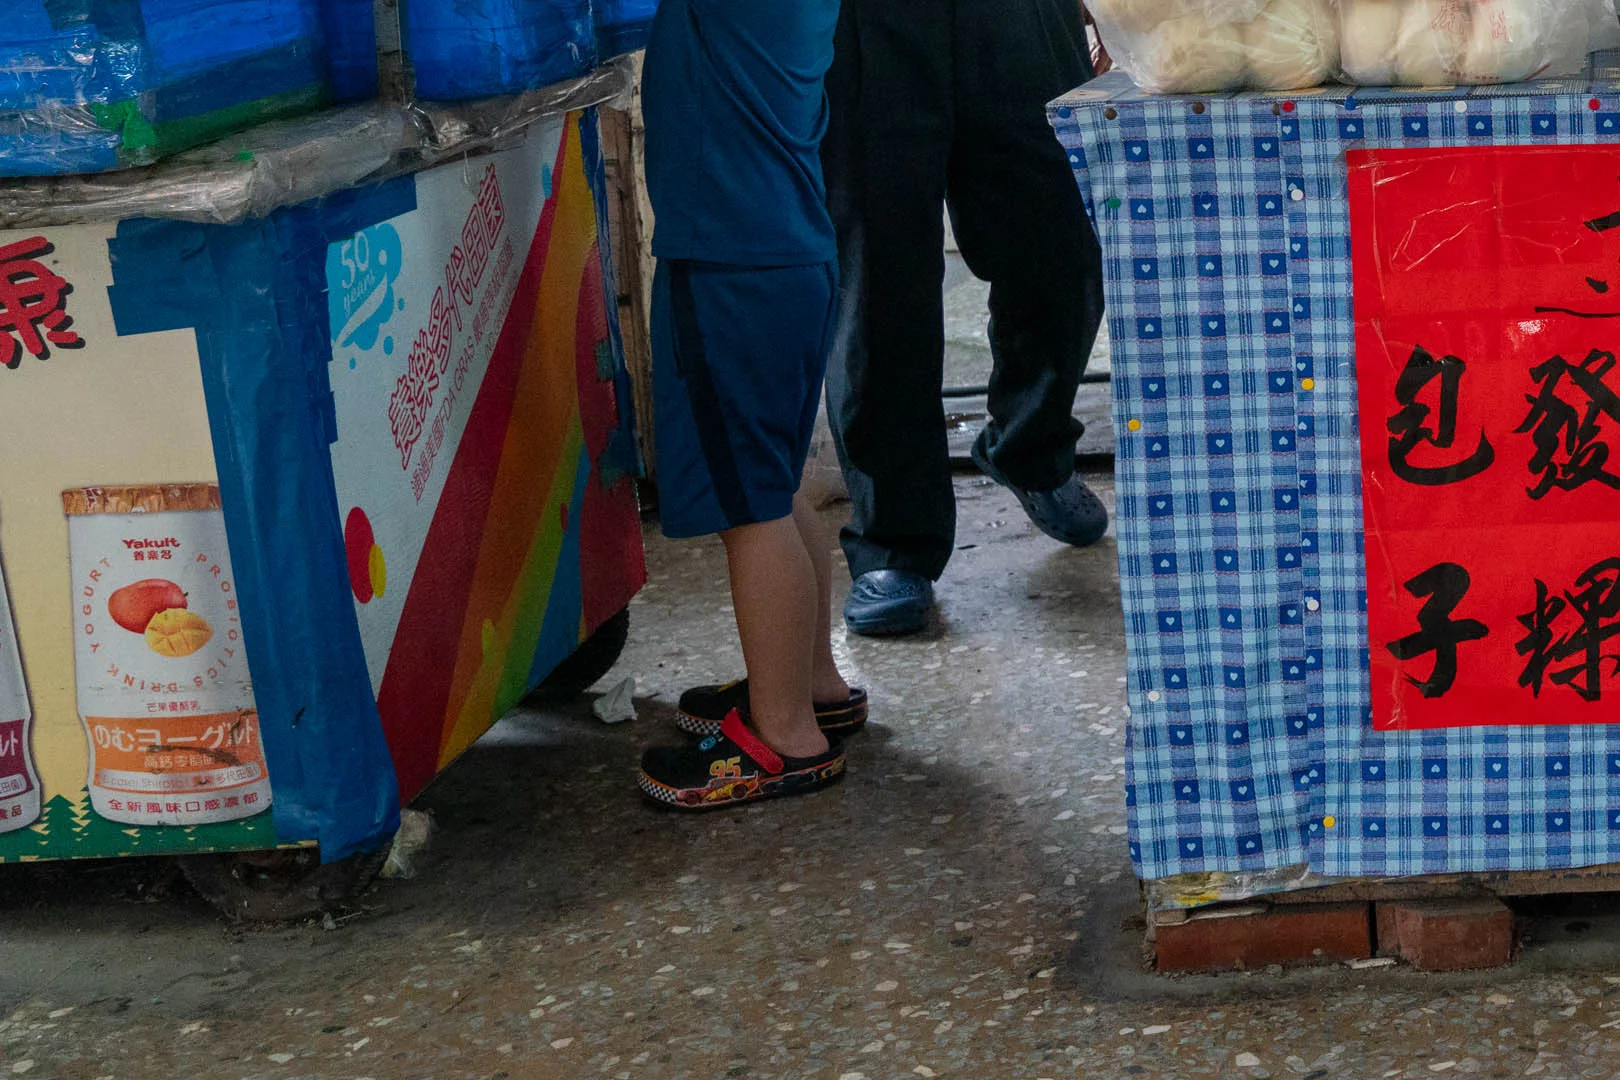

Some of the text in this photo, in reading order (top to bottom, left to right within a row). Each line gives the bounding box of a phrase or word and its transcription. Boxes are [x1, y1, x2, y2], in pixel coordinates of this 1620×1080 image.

[341, 231, 369, 290] 50
[122, 537, 181, 550] Yakult
[81, 556, 113, 654] YOGURT
[94, 717, 254, 753] のむヨーグルト
[709, 756, 742, 778] 95
